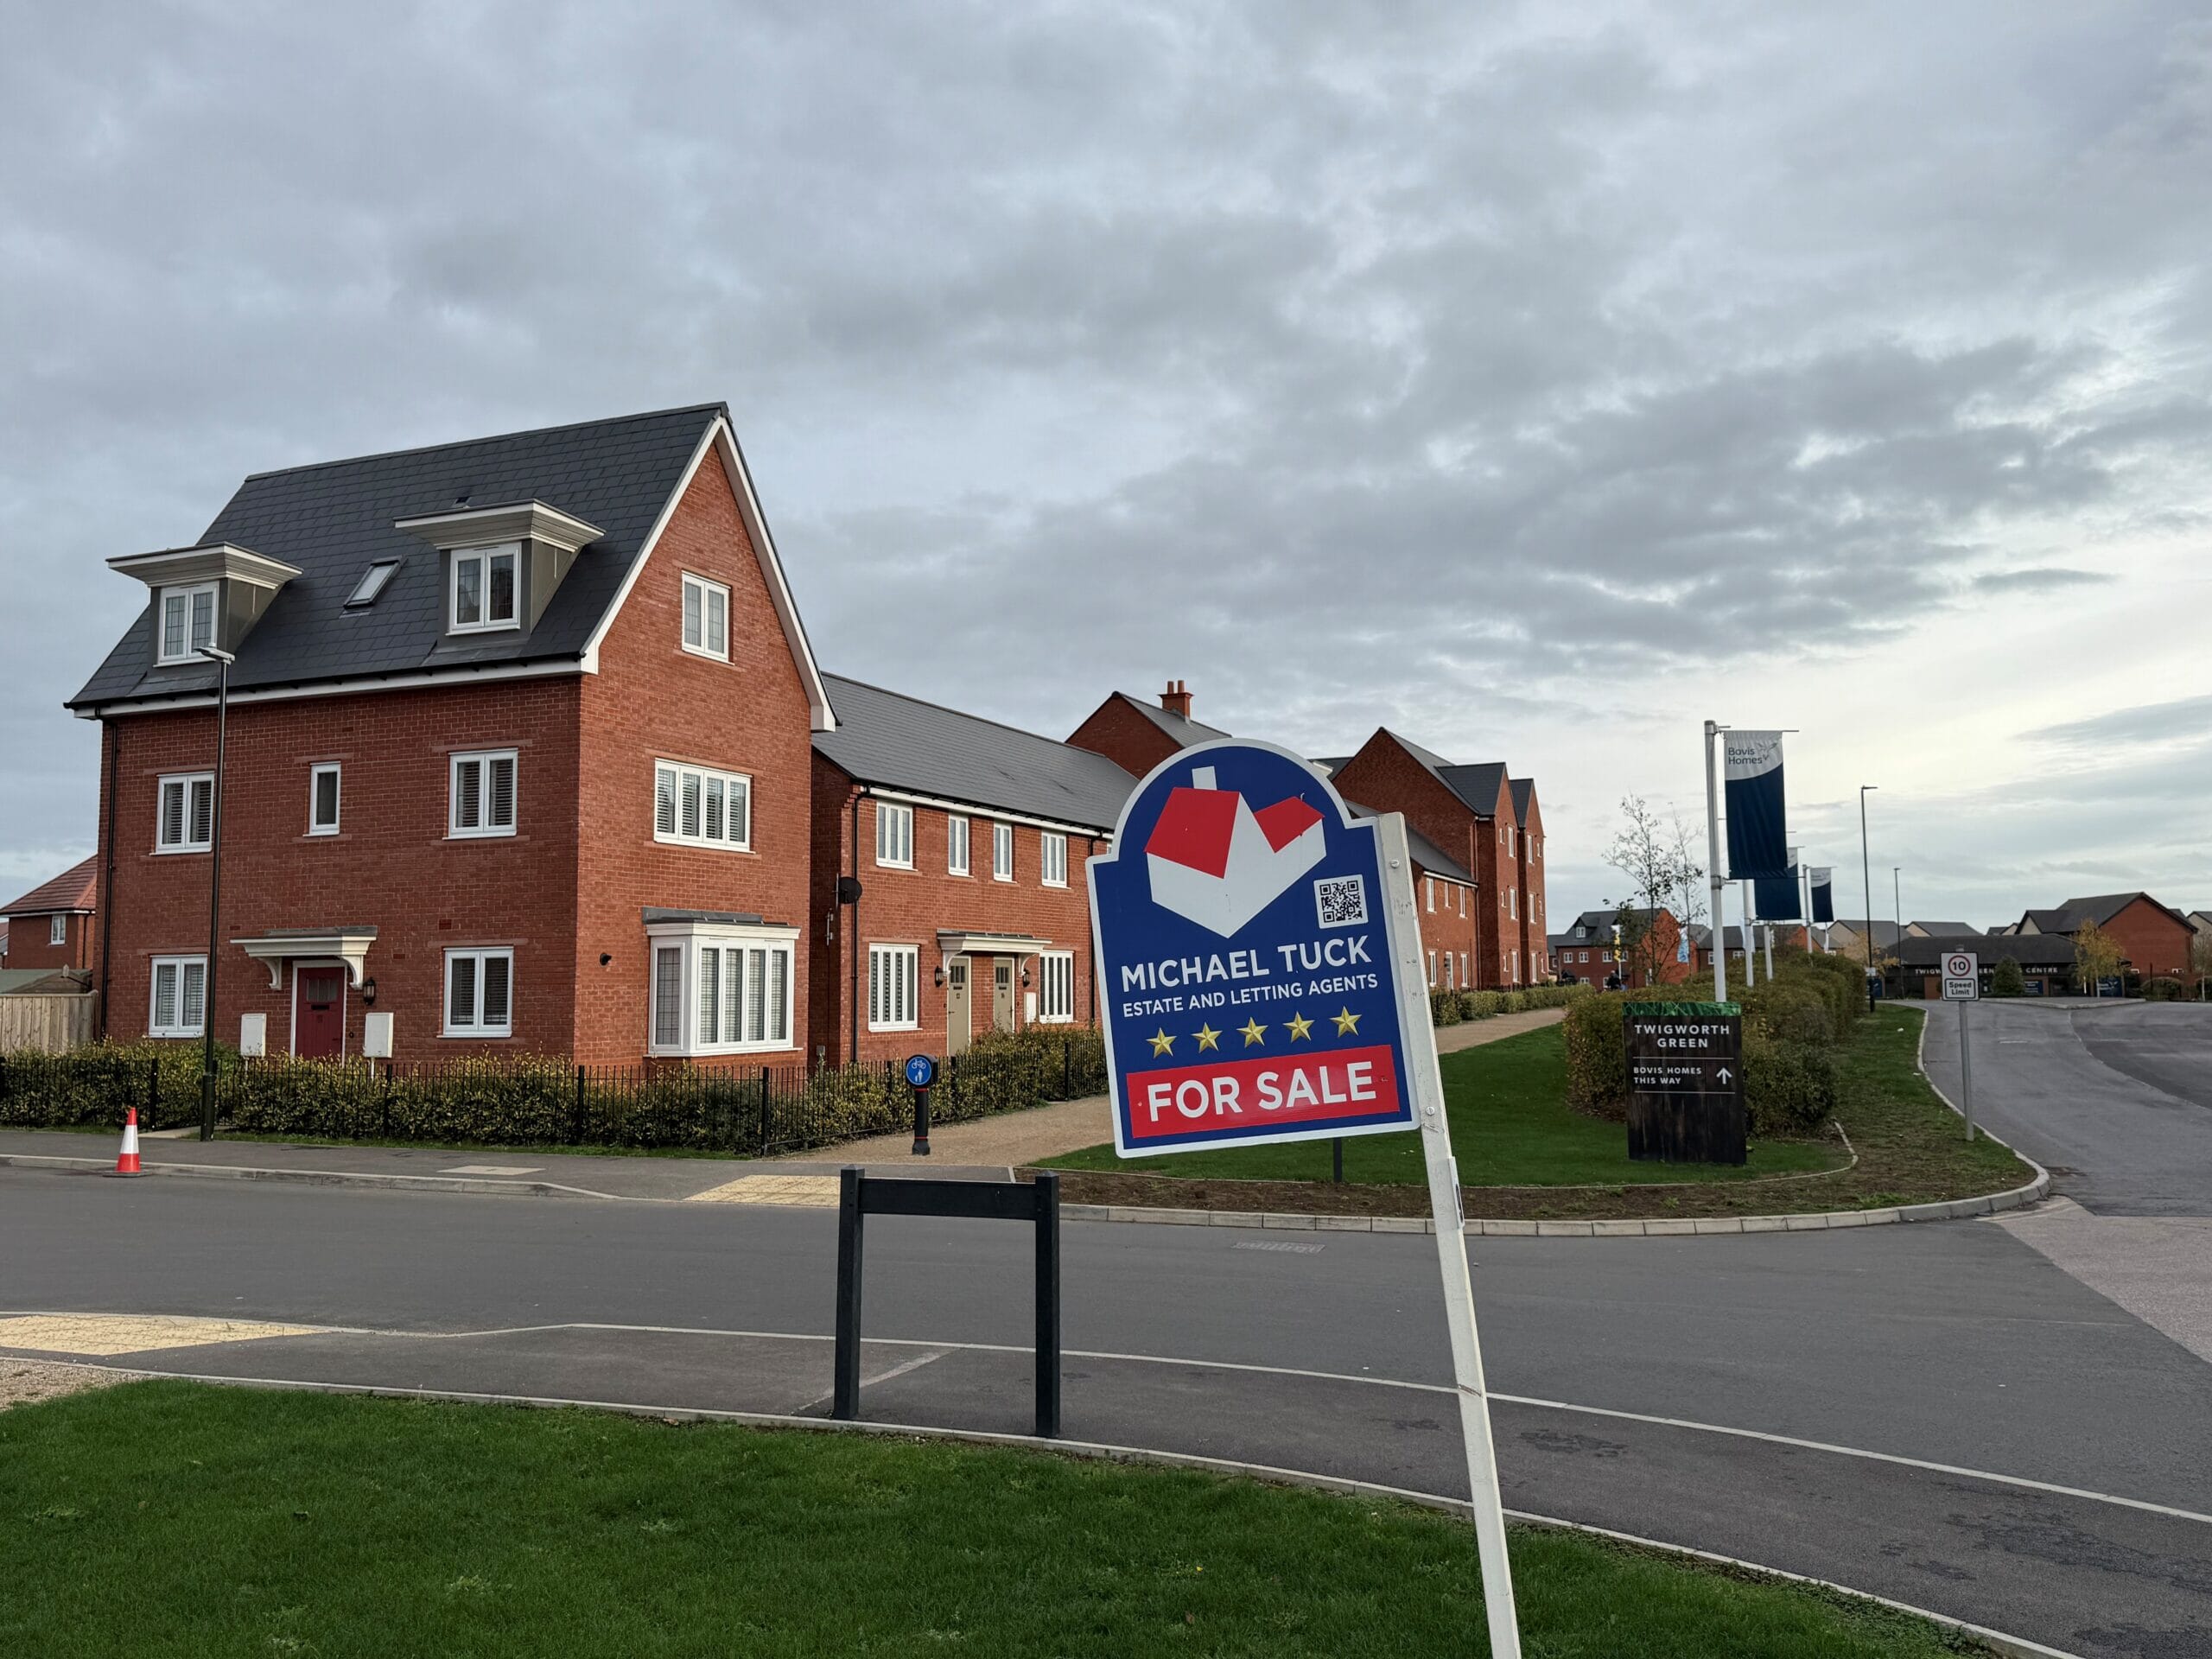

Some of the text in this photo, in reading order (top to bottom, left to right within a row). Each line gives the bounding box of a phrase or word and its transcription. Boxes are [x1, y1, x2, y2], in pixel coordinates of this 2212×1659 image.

[1728, 747, 1755, 756] Bovis
[1728, 756, 1763, 765] Homes
[1121, 936, 1372, 992] MICHAEL TUCK
[1953, 961, 1967, 970] 10
[1122, 973, 1378, 1017] ESTATE AND LETTING AGENTS
[1634, 1024, 1730, 1035] TWIGWORTH
[1656, 1038, 1708, 1048] GREEN
[1147, 1060, 1376, 1122] FOR SALE
